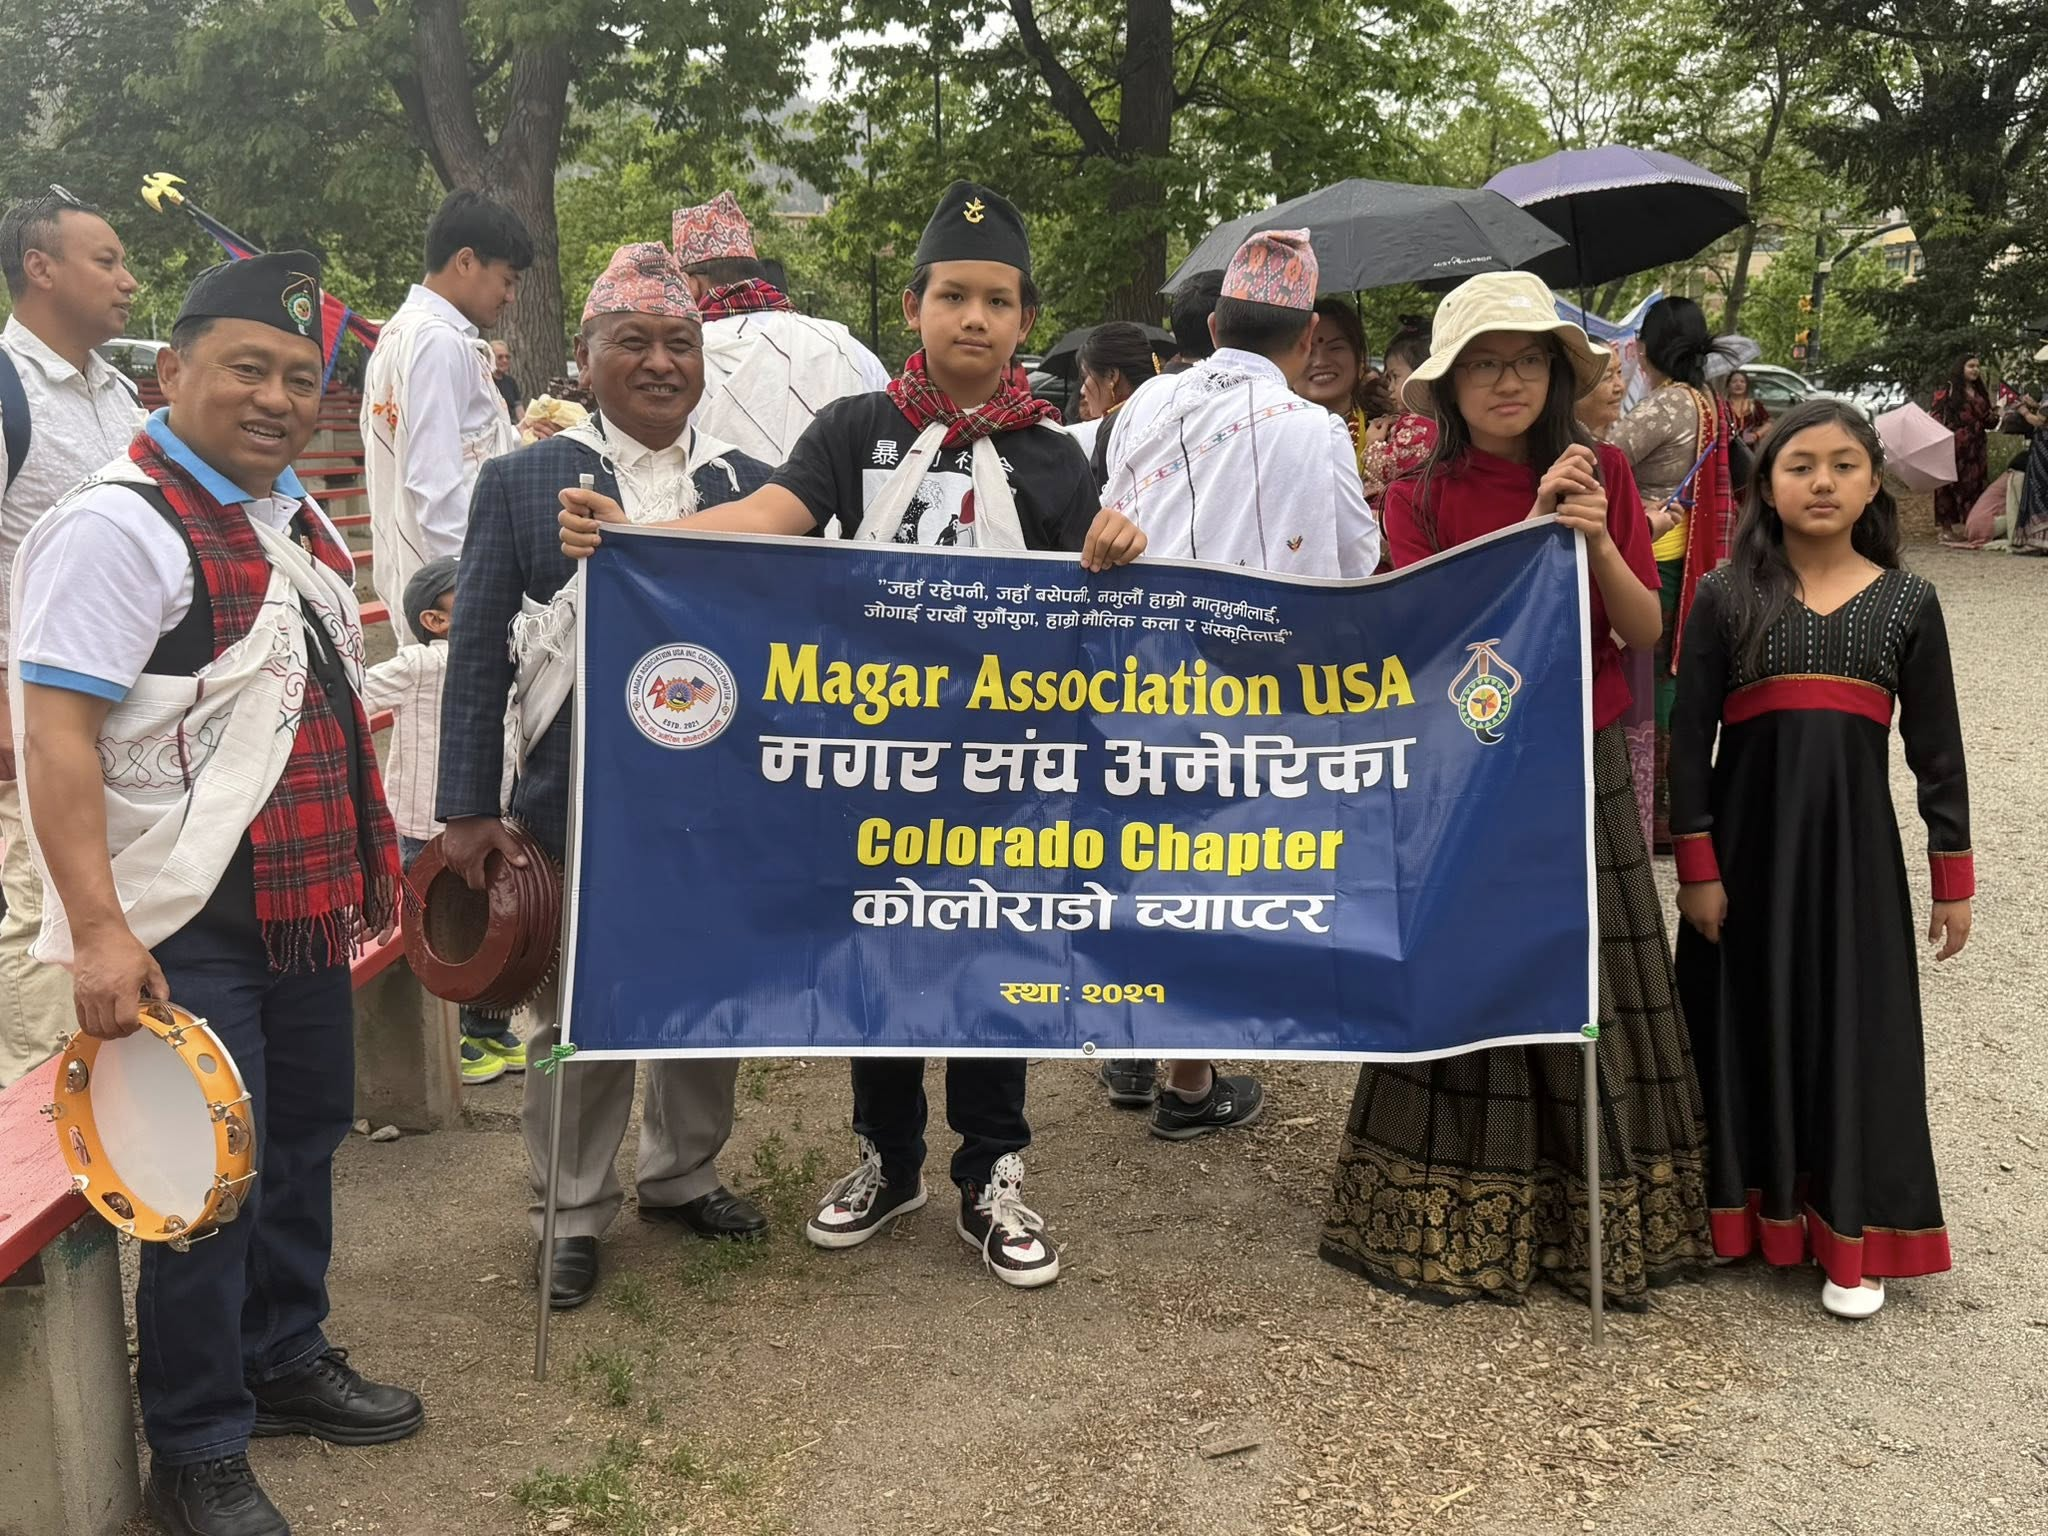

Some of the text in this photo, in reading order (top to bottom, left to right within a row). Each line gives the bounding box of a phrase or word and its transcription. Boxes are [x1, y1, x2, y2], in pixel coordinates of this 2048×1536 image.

[864, 601, 923, 623] जोगाई
[1046, 610, 1080, 630] हाम्रो
[1082, 609, 1136, 628] मौलिक
[1141, 616, 1180, 631] कला
[1185, 618, 1196, 632] र
[929, 580, 989, 600] रहेपनी,
[996, 584, 1031, 604] जहाँ
[1035, 585, 1090, 604] बसेपनी,
[1149, 590, 1187, 609] हाम्रो
[633, 674, 643, 695] MAGAR
[640, 650, 672, 675] ASSOCIATION
[672, 648, 684, 657] USA
[698, 653, 724, 677] COLORADO
[719, 673, 731, 700] CHAPTER
[763, 642, 1416, 725] Magar Association USA
[684, 720, 700, 730] 2021
[759, 728, 1416, 799] मगर संघ अमेरिका
[857, 817, 1343, 877] Colorado Chapter
[852, 877, 1336, 934] कोलोराडो च्याप्टर
[1081, 984, 1165, 1004] २०२१
